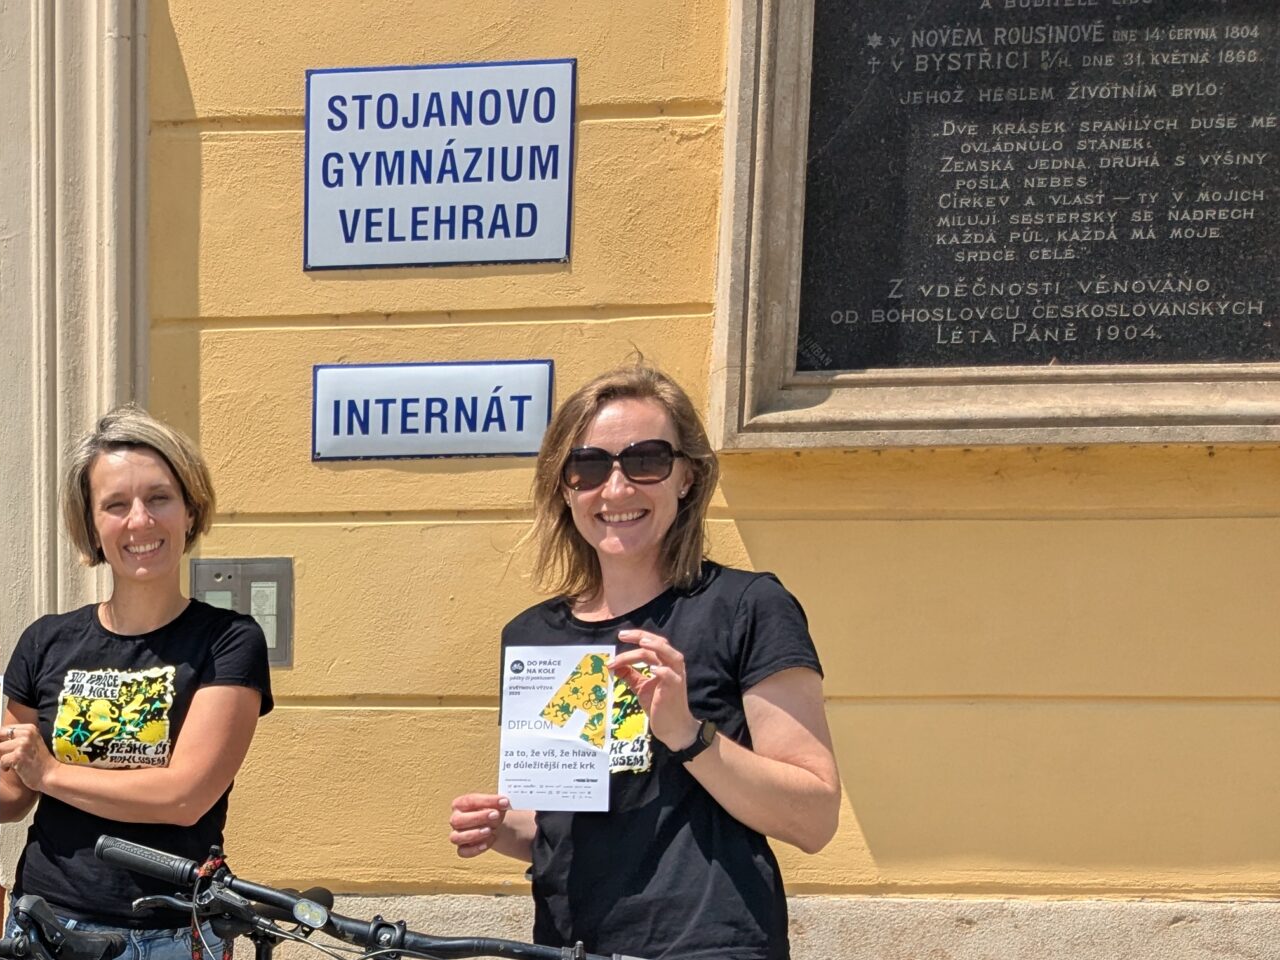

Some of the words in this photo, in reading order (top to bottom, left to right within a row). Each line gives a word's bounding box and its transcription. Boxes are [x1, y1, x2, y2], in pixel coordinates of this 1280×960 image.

[1113, 29, 1137, 43] DNE
[1224, 24, 1260, 39] 1804
[1082, 54, 1116, 67] DNE
[979, 86, 1055, 102] HESLEM
[327, 87, 557, 132] STOJANOVO
[992, 117, 1066, 135] KRÁSEK
[1251, 112, 1278, 129] MÉ
[321, 139, 559, 188] GYMNÁZIUM
[1099, 151, 1161, 169] DRUHÁ
[1174, 154, 1186, 167] S
[1023, 195, 1036, 206] A
[1138, 192, 1160, 205] TY
[1196, 188, 1265, 203] MOJICH
[339, 203, 538, 244] VELEHRAD
[1008, 210, 1119, 226] SESTERSKY
[1130, 225, 1157, 240] MÁ
[954, 249, 1016, 263] SRDCE
[887, 278, 906, 299] Z
[920, 275, 1061, 299] VDĚČNOSTI
[1078, 273, 1211, 294] VĚNOVÁNO
[830, 309, 859, 325] OD
[1012, 321, 1078, 343] PÁNĚ
[333, 386, 532, 435] INTERNÁT
[508, 720, 553, 730] DIPLOM
[516, 750, 528, 758] to,
[530, 748, 540, 757] že
[542, 748, 558, 759] víš,
[560, 748, 570, 757] že
[503, 762, 511, 771] je
[562, 762, 577, 770] než
